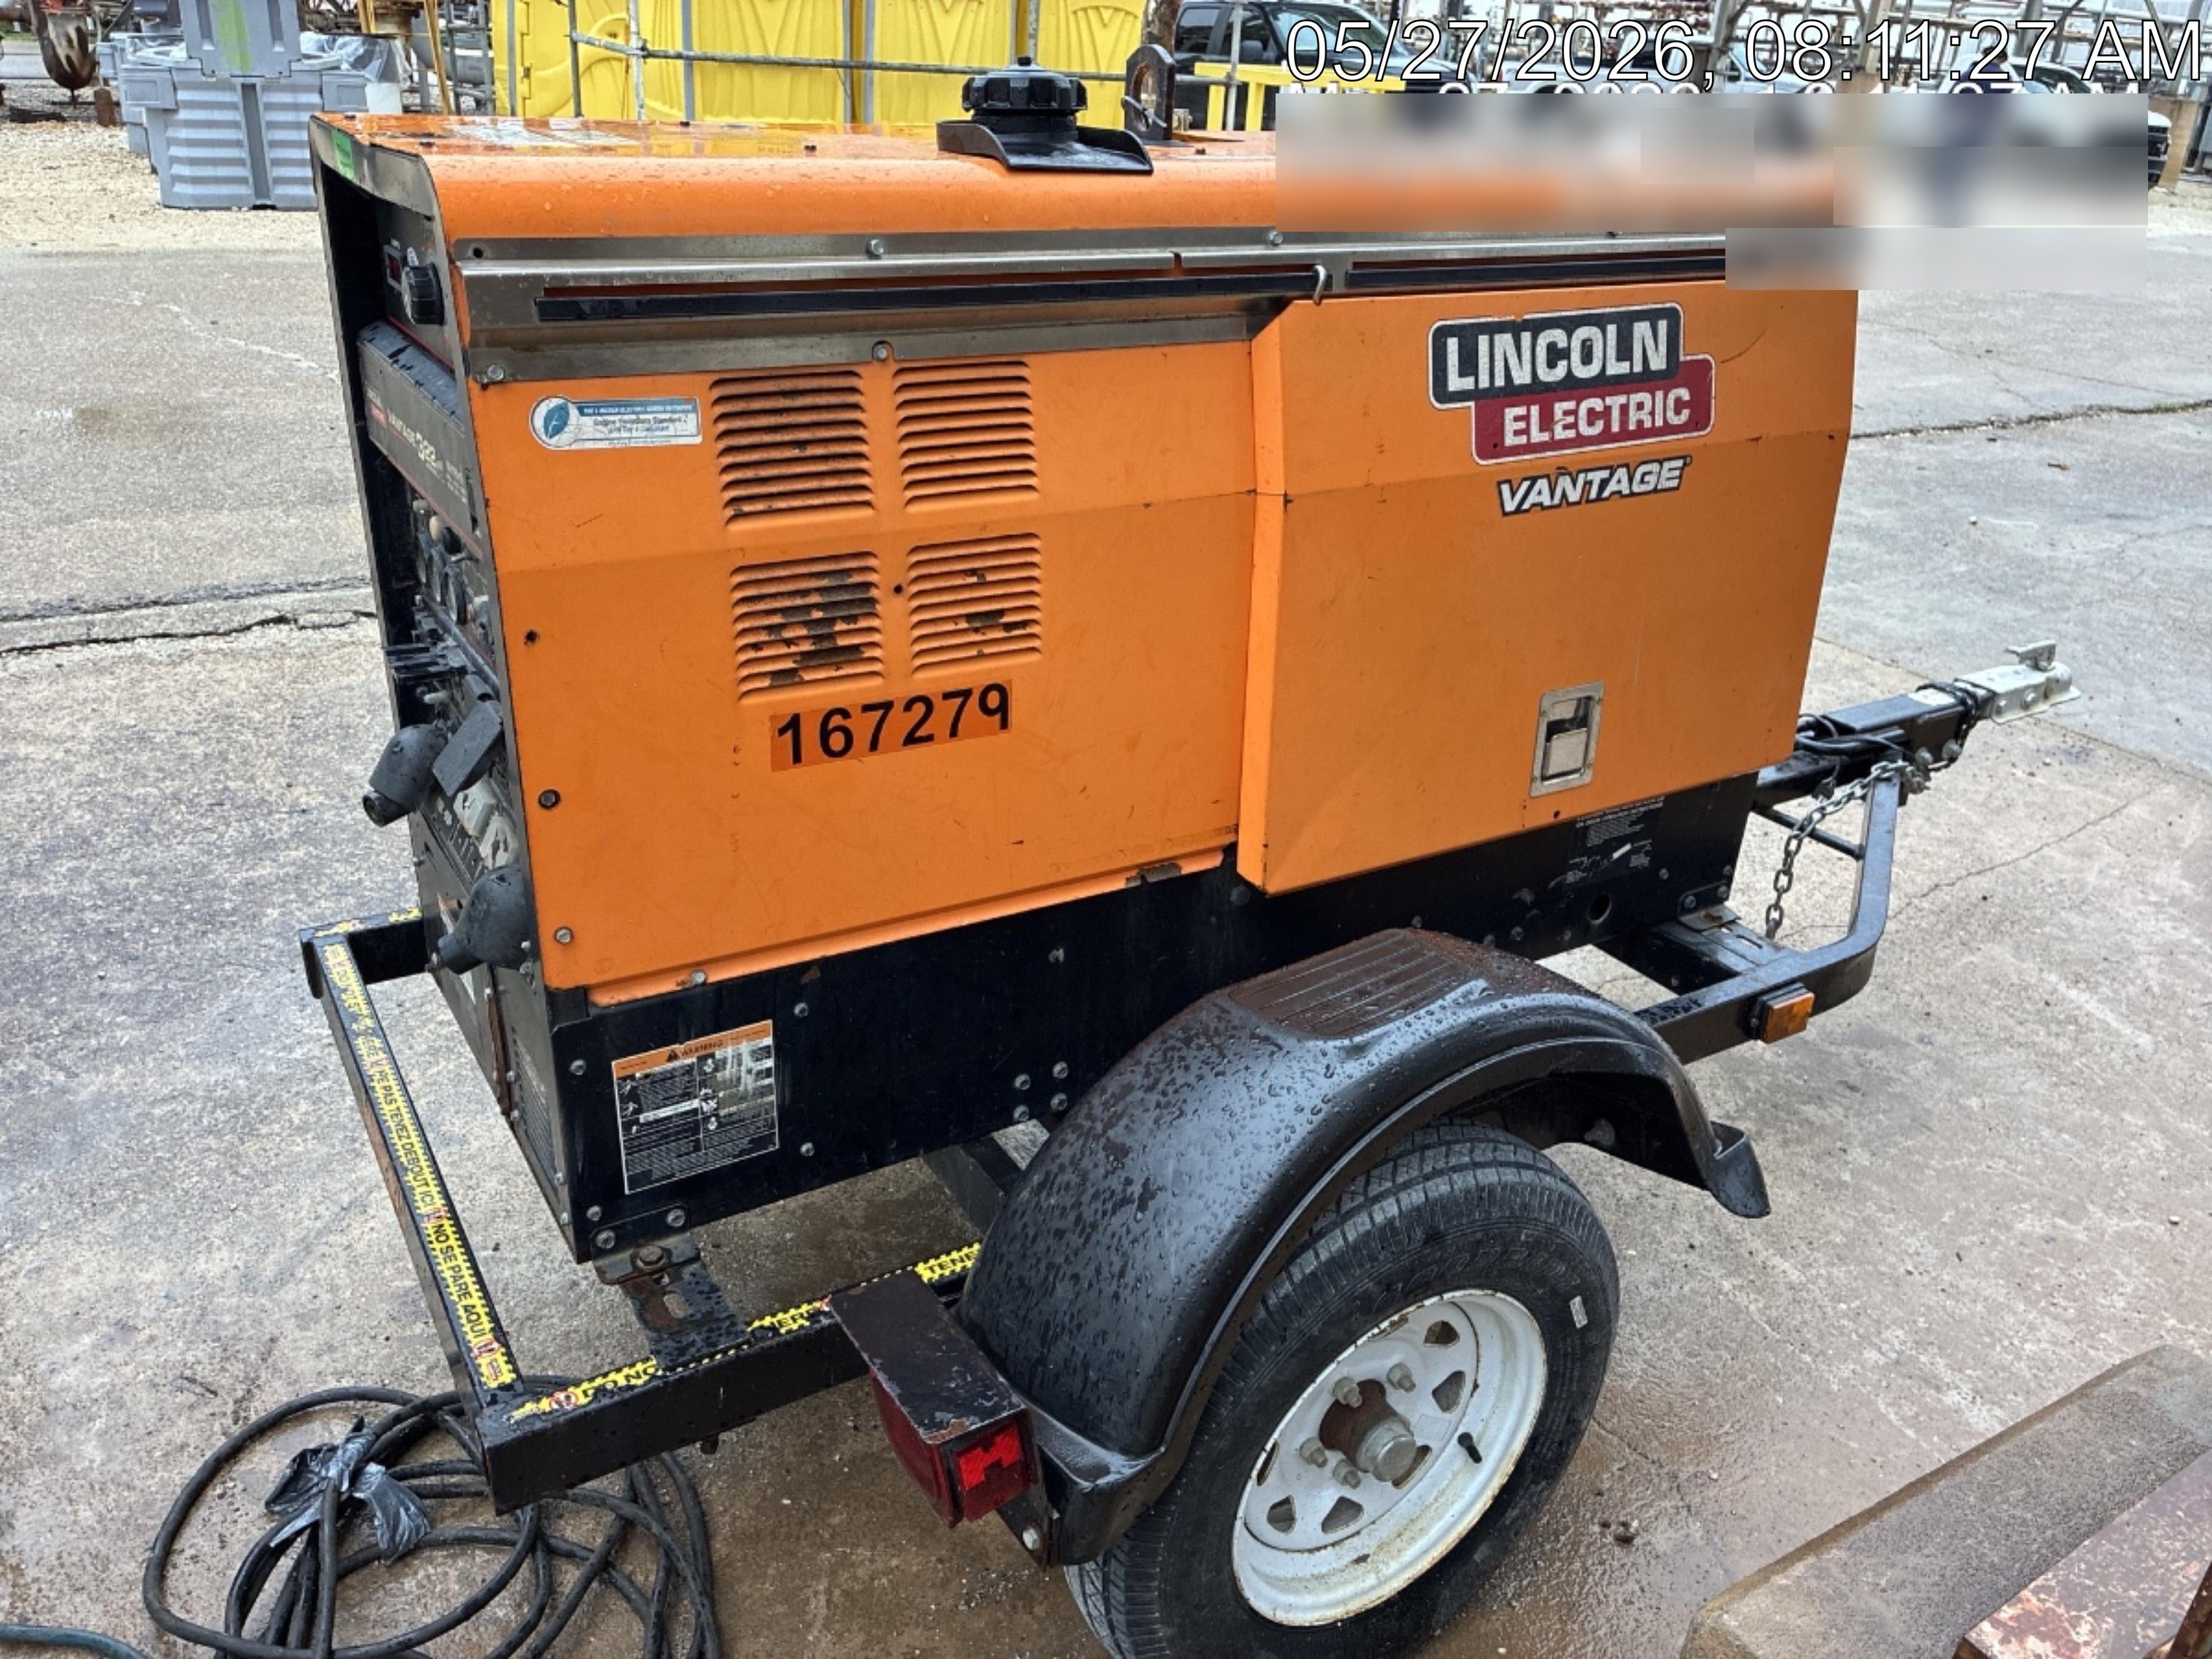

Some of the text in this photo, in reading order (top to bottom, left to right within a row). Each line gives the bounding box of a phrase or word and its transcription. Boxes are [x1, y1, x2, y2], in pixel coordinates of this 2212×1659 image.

[1446, 319, 1668, 391] LINCOLN
[1504, 386, 1690, 447] ELECTRIC
[1498, 459, 1684, 515] VANTAGE
[777, 683, 1010, 766] 167279
[680, 1039, 724, 1057] WARNING
[381, 1085, 398, 1105] PAS
[401, 1142, 430, 1188] DEBOUT
[431, 1223, 488, 1339] NO SE PARE AQUI
[923, 1251, 979, 1274] TENE
